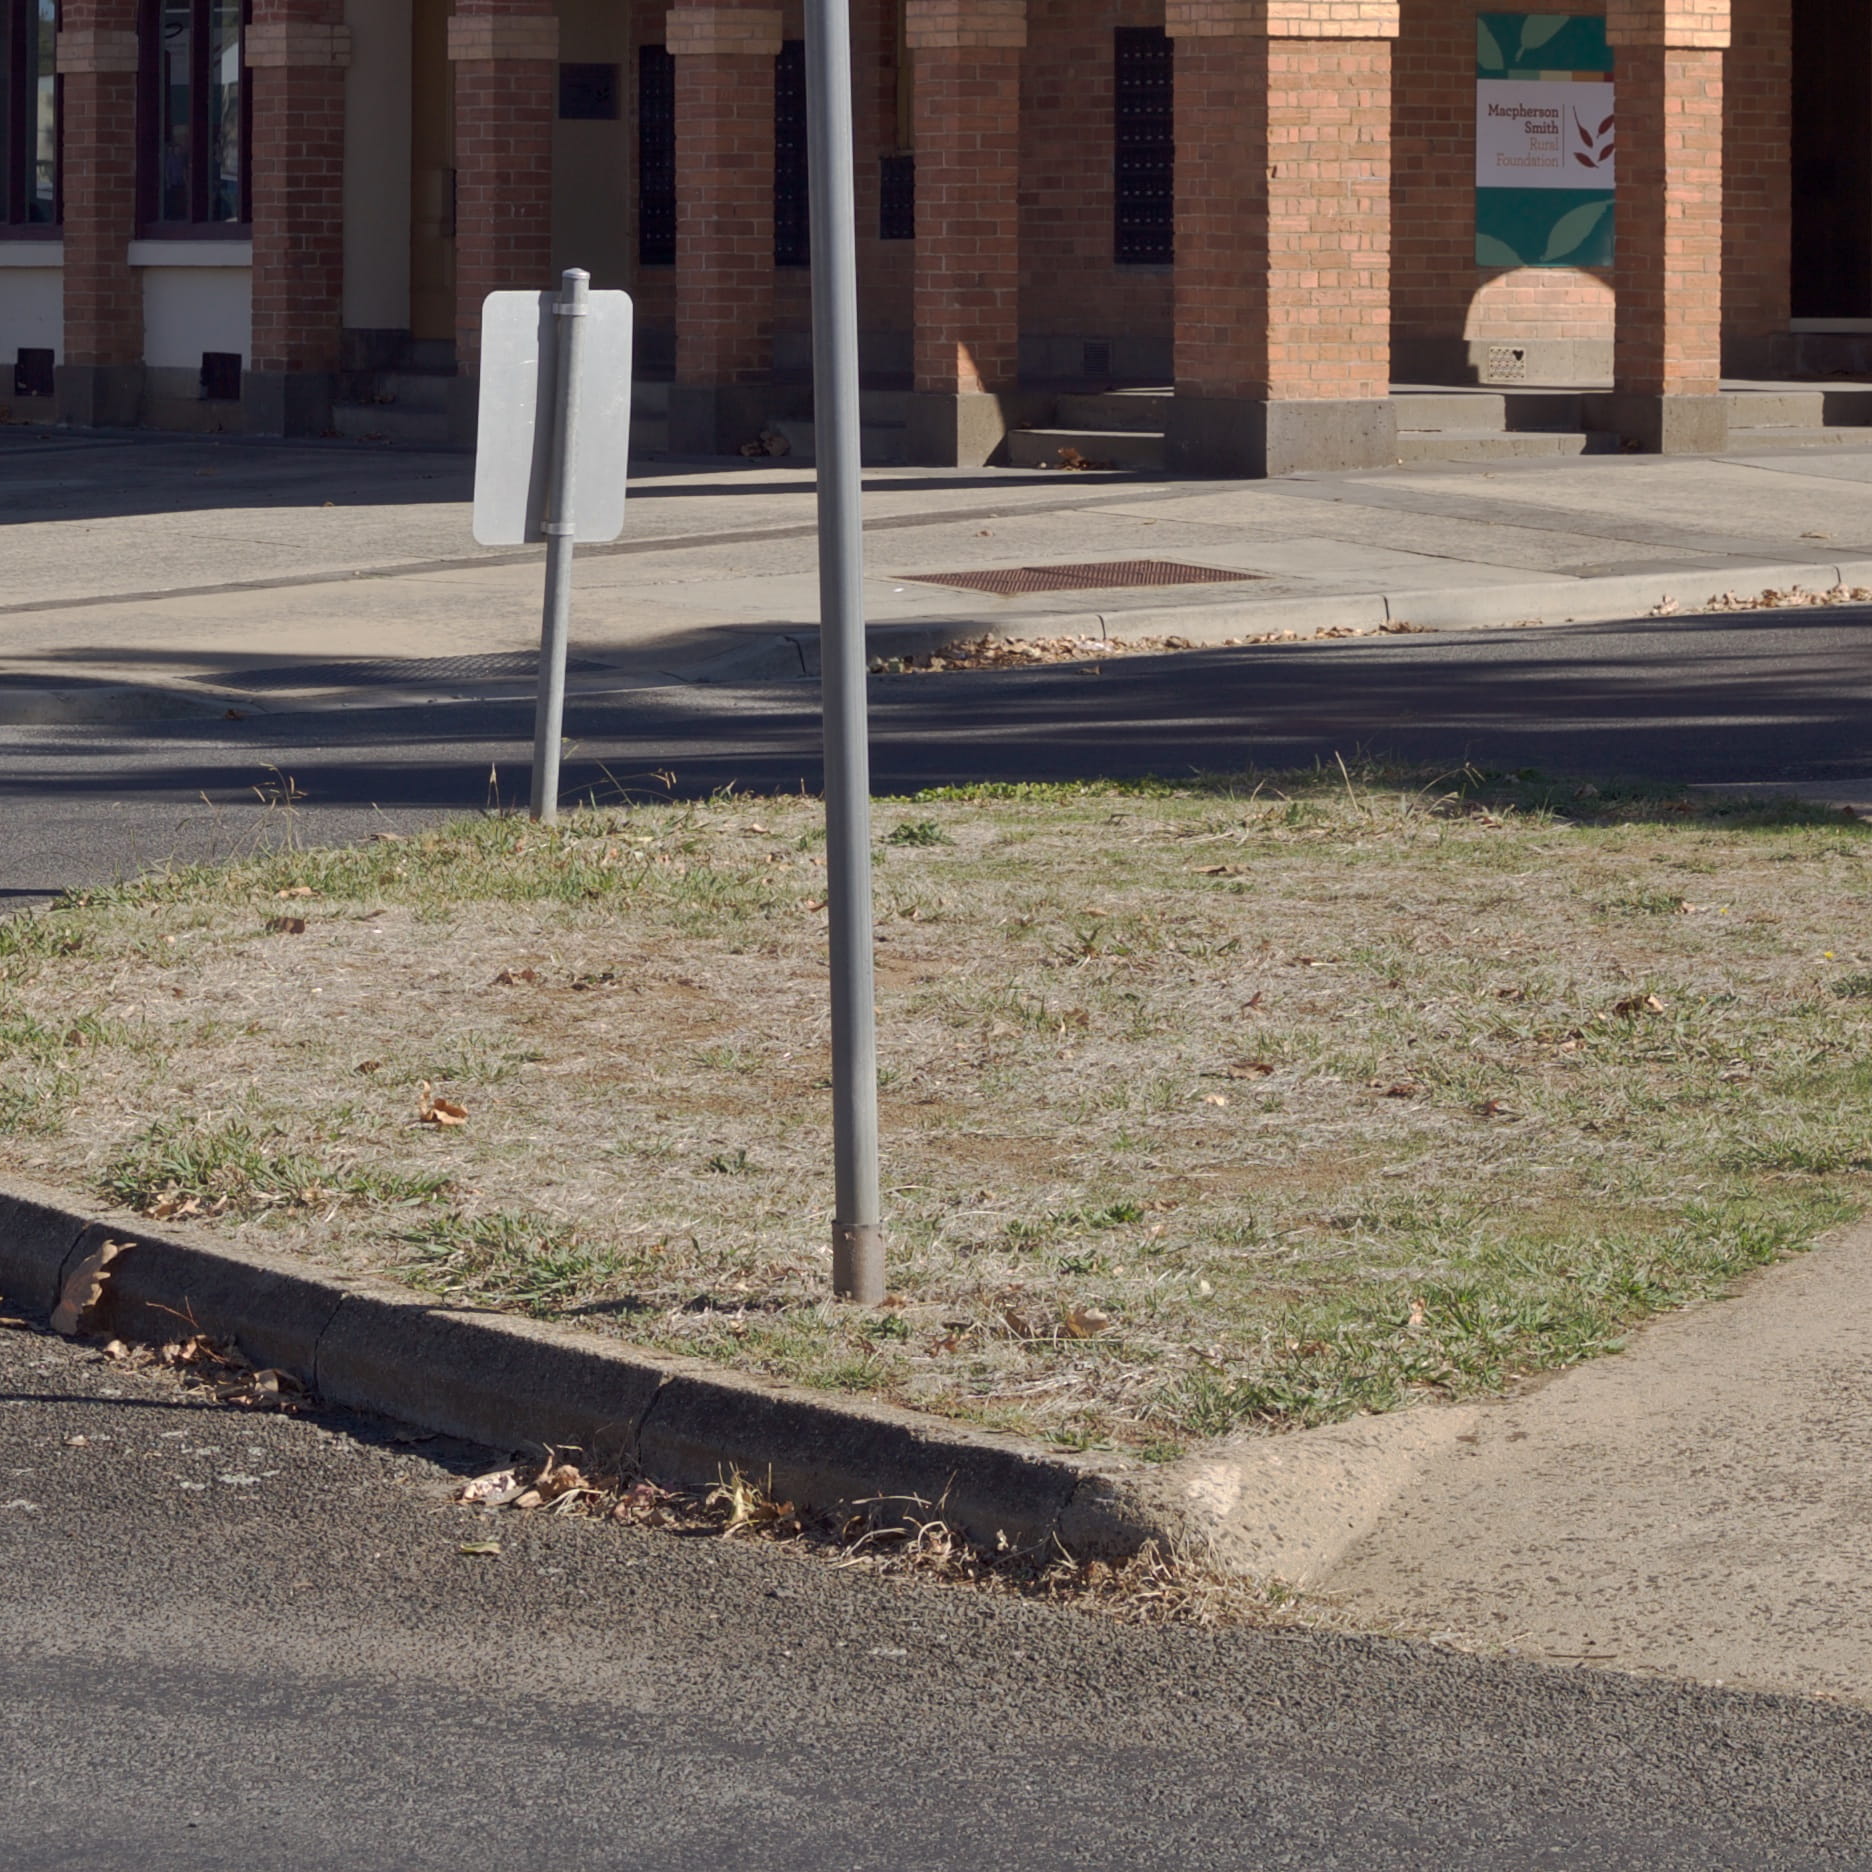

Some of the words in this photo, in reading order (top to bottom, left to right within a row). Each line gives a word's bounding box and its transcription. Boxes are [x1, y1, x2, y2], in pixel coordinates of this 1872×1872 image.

[1488, 103, 1559, 120] Macpherson
[1524, 120, 1559, 134] Smith
[1530, 136, 1559, 151] Rural
[1496, 152, 1559, 168] Foundation
